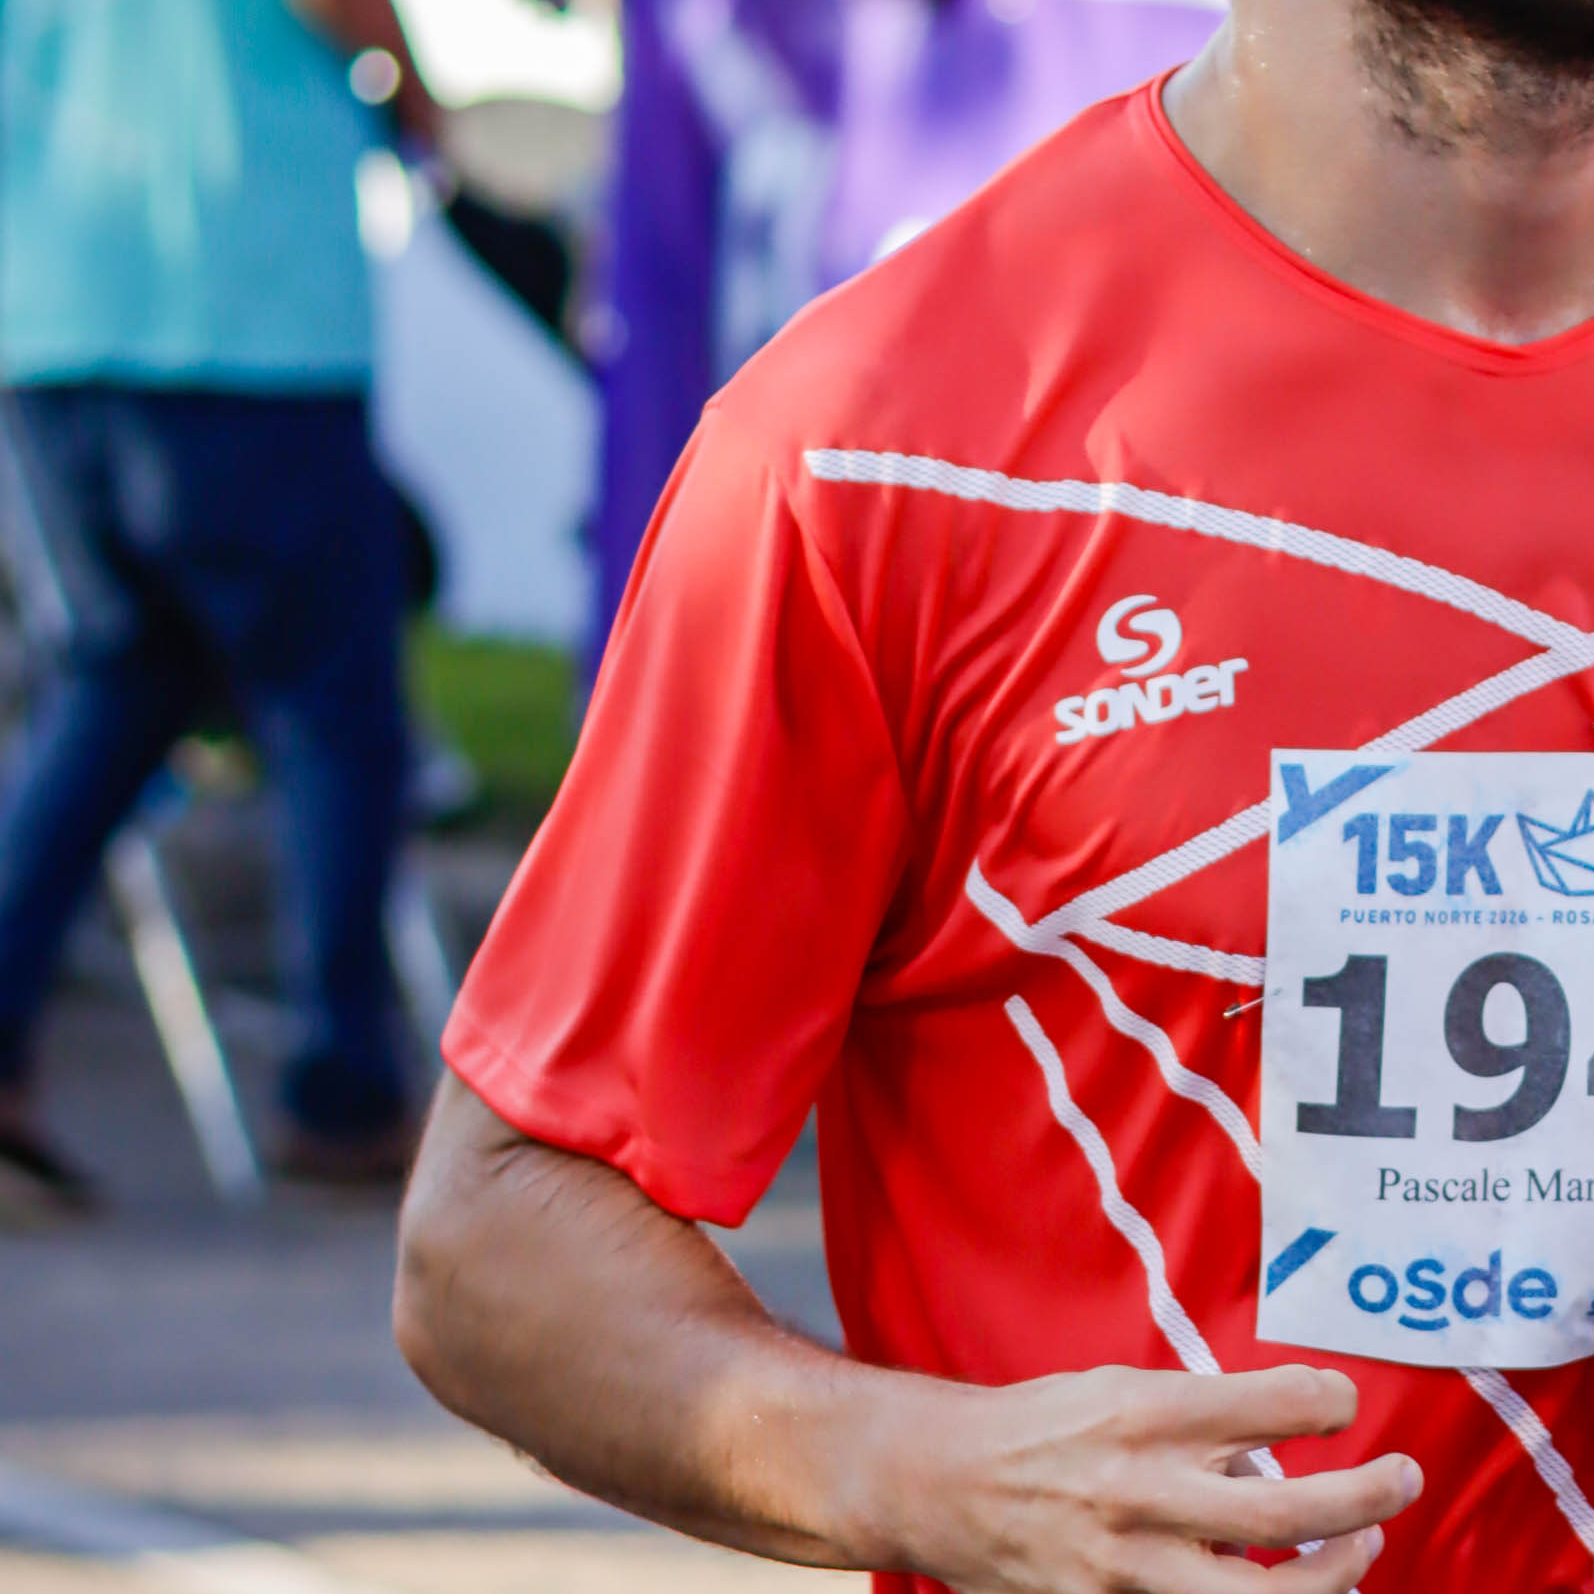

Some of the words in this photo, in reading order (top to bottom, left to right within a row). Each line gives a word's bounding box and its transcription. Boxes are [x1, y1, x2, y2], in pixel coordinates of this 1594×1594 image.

[1342, 811, 1505, 897] 15K
[1339, 908, 1417, 925] PUERTO
[1424, 909, 1483, 925] NORTE
[1488, 909, 1529, 925] 2026
[1377, 1167, 1512, 1202] Pascale
[1348, 1249, 1559, 1321] osde
